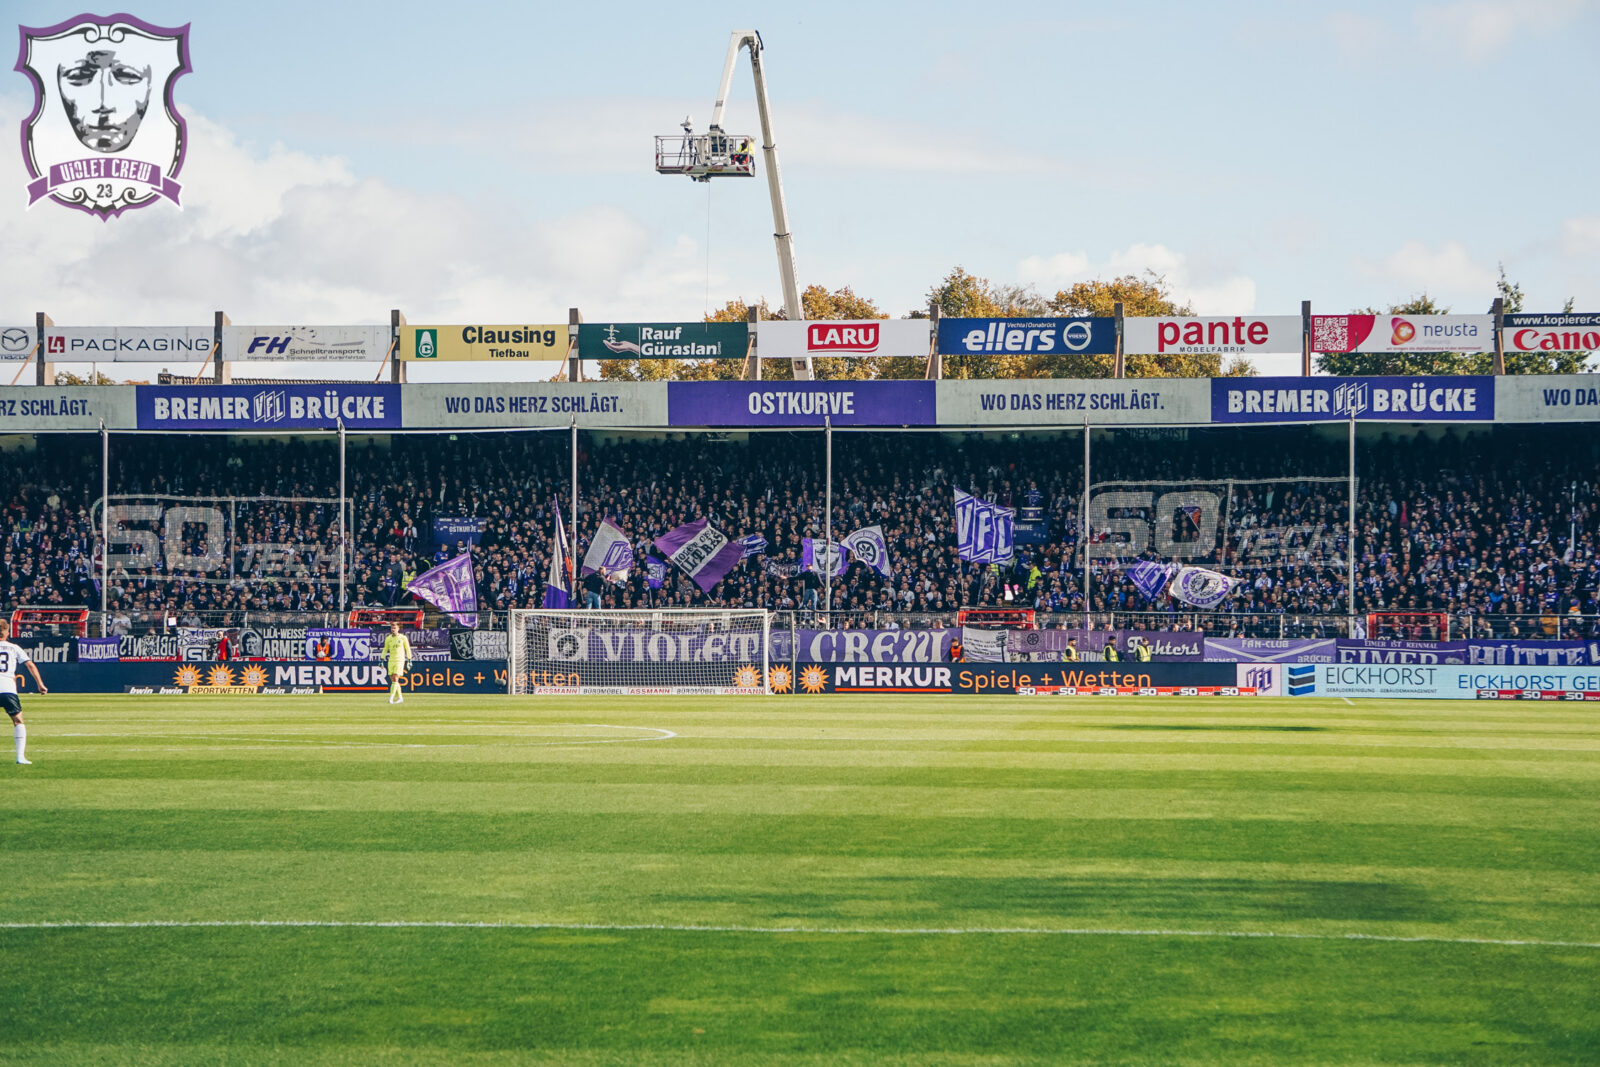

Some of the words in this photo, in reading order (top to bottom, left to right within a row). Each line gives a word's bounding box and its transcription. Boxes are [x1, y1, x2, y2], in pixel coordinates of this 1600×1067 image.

[462, 326, 556, 347] Clausing
[641, 327, 682, 340] Rauf
[812, 328, 875, 345] LARU
[962, 322, 1056, 351] ellers
[1158, 317, 1269, 352] pante
[1423, 323, 1478, 336] neusta
[71, 337, 210, 352] PACKAGING
[247, 337, 292, 354] FH
[290, 348, 366, 356] Schnelltransporte
[641, 341, 717, 356] Güraslan
[489, 349, 529, 358] Tiefbau
[21, 396, 92, 416] SCHLÄGT.
[155, 397, 249, 420] BREMER
[290, 391, 385, 420] BRÜCKE
[445, 396, 472, 414] WO
[474, 396, 506, 414] DAS
[509, 396, 548, 413] HERZ
[551, 392, 624, 414] SCHLÄGT.
[748, 391, 855, 415] OSTKURVE
[980, 394, 1007, 411] WO
[1010, 394, 1042, 411] DAS
[1045, 394, 1086, 411] HERZ
[1090, 389, 1165, 411] SCHLÄGT.
[1228, 390, 1330, 413] BREMER
[1373, 382, 1477, 412] BRÜCKE
[1543, 389, 1571, 406] WO
[1575, 389, 1600, 406] DA
[263, 628, 306, 639] LILA-WEISSE
[262, 640, 306, 657] ARMEE
[594, 632, 760, 662] VIOLET
[1242, 640, 1289, 648] FAN-CLUB
[275, 666, 388, 685] MERKUR
[399, 668, 465, 691] Spiele
[835, 667, 952, 687] MERKUR
[959, 670, 1031, 693] Spiele
[1040, 673, 1053, 685] +
[1061, 670, 1151, 687] Wetten
[1326, 667, 1438, 685] EICKHORST
[1458, 674, 1567, 690] EICKHORST
[1572, 676, 1600, 690] GE
[130, 687, 154, 695] bwin
[159, 687, 183, 695] bwin
[192, 687, 254, 695] SPORTWETTEN
[262, 686, 286, 695] bwin
[291, 686, 315, 695] bwin
